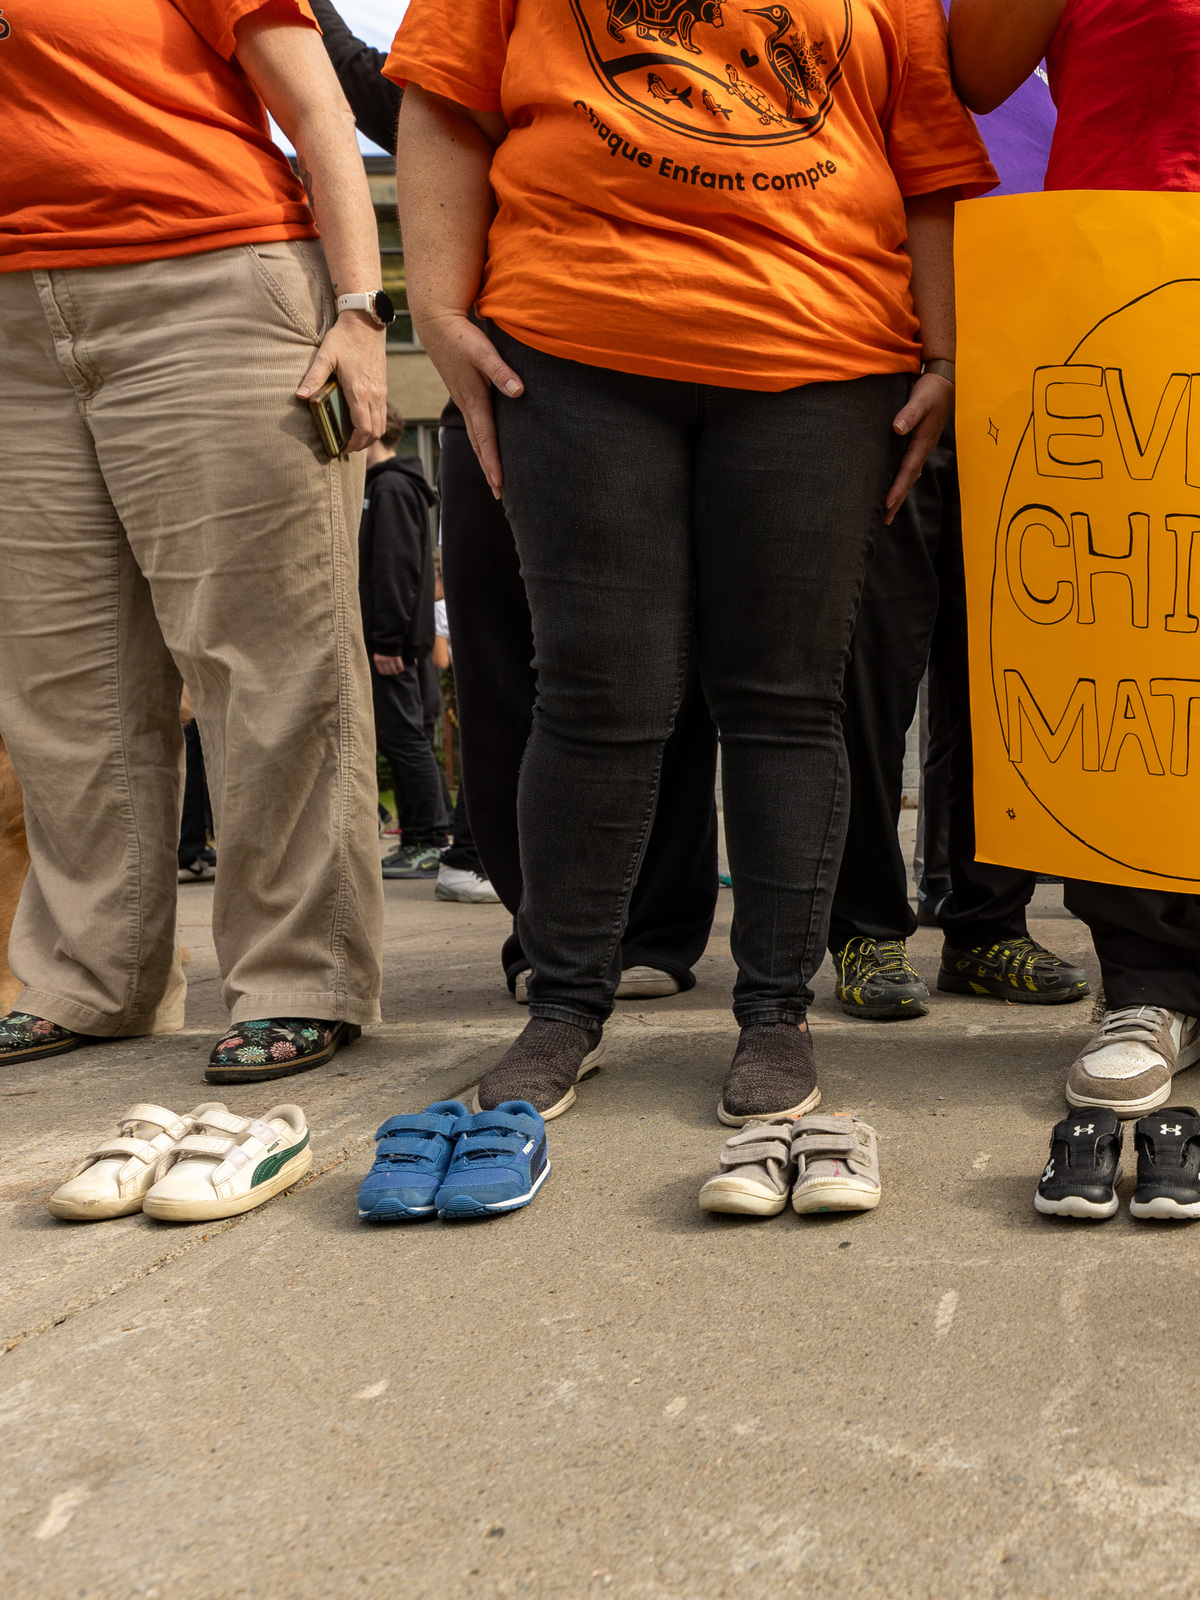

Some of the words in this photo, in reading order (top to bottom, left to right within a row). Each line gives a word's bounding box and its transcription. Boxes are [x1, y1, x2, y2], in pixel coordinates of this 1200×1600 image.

[573, 100, 653, 168] Chaque
[658, 156, 745, 191] Enfant
[751, 159, 837, 192] Compte
